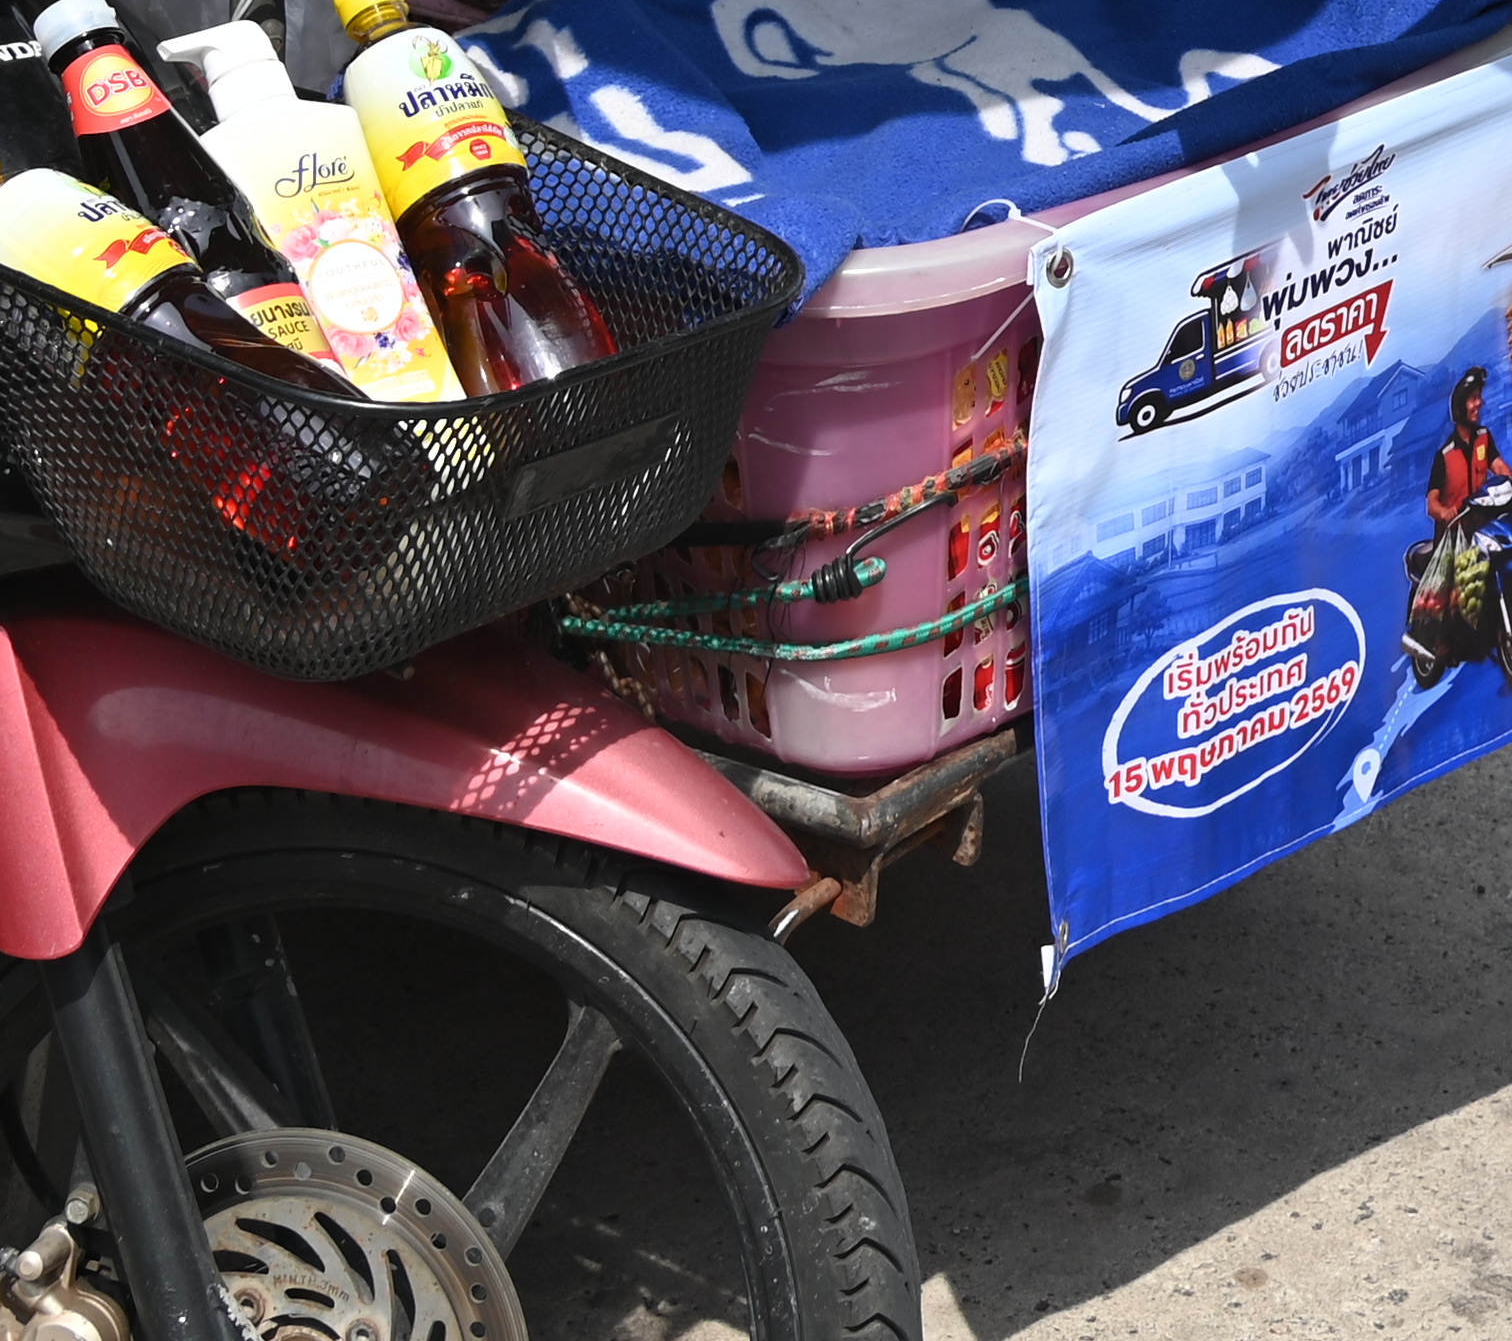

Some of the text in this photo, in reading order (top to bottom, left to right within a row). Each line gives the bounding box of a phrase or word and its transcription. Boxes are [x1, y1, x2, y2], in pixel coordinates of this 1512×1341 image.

[86, 69, 149, 107] DSB
[398, 72, 494, 118] ปลาหมึก
[1327, 204, 1399, 260] พาณิชย์
[1262, 248, 1399, 332] พุ่มพวง...
[268, 320, 310, 340] SAUCE
[1285, 291, 1379, 359] ลดราคา
[1166, 609, 1314, 696] เริ่มพร้อมกัน
[1181, 658, 1305, 735] ทั่วประเทศ
[1108, 665, 1356, 799] 15 พฤษภาคม 2569
